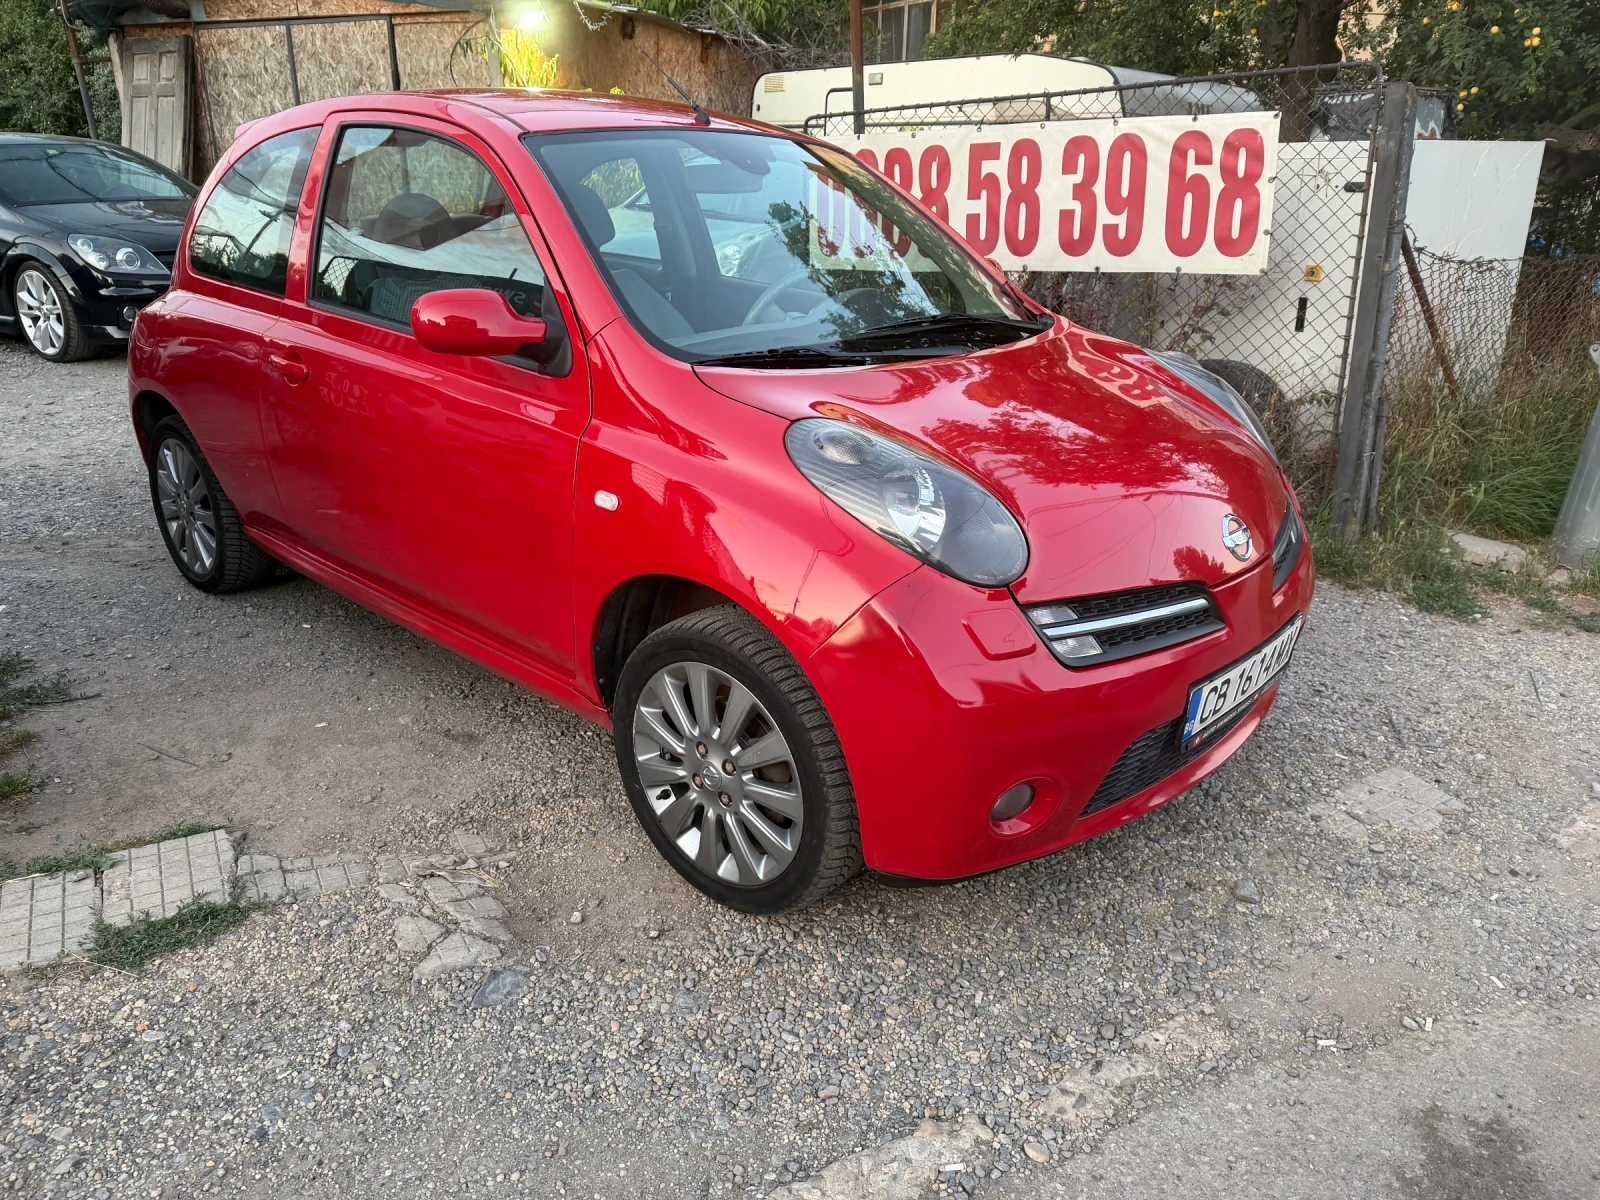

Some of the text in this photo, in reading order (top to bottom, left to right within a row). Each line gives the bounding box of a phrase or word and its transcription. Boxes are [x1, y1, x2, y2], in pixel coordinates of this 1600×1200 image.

[965, 138, 1042, 257] 58
[1058, 133, 1148, 257] 39
[1165, 128, 1265, 257] 68
[1199, 677, 1231, 724] CB
[1232, 644, 1278, 703] 1614
[1184, 719, 1195, 734] BG
